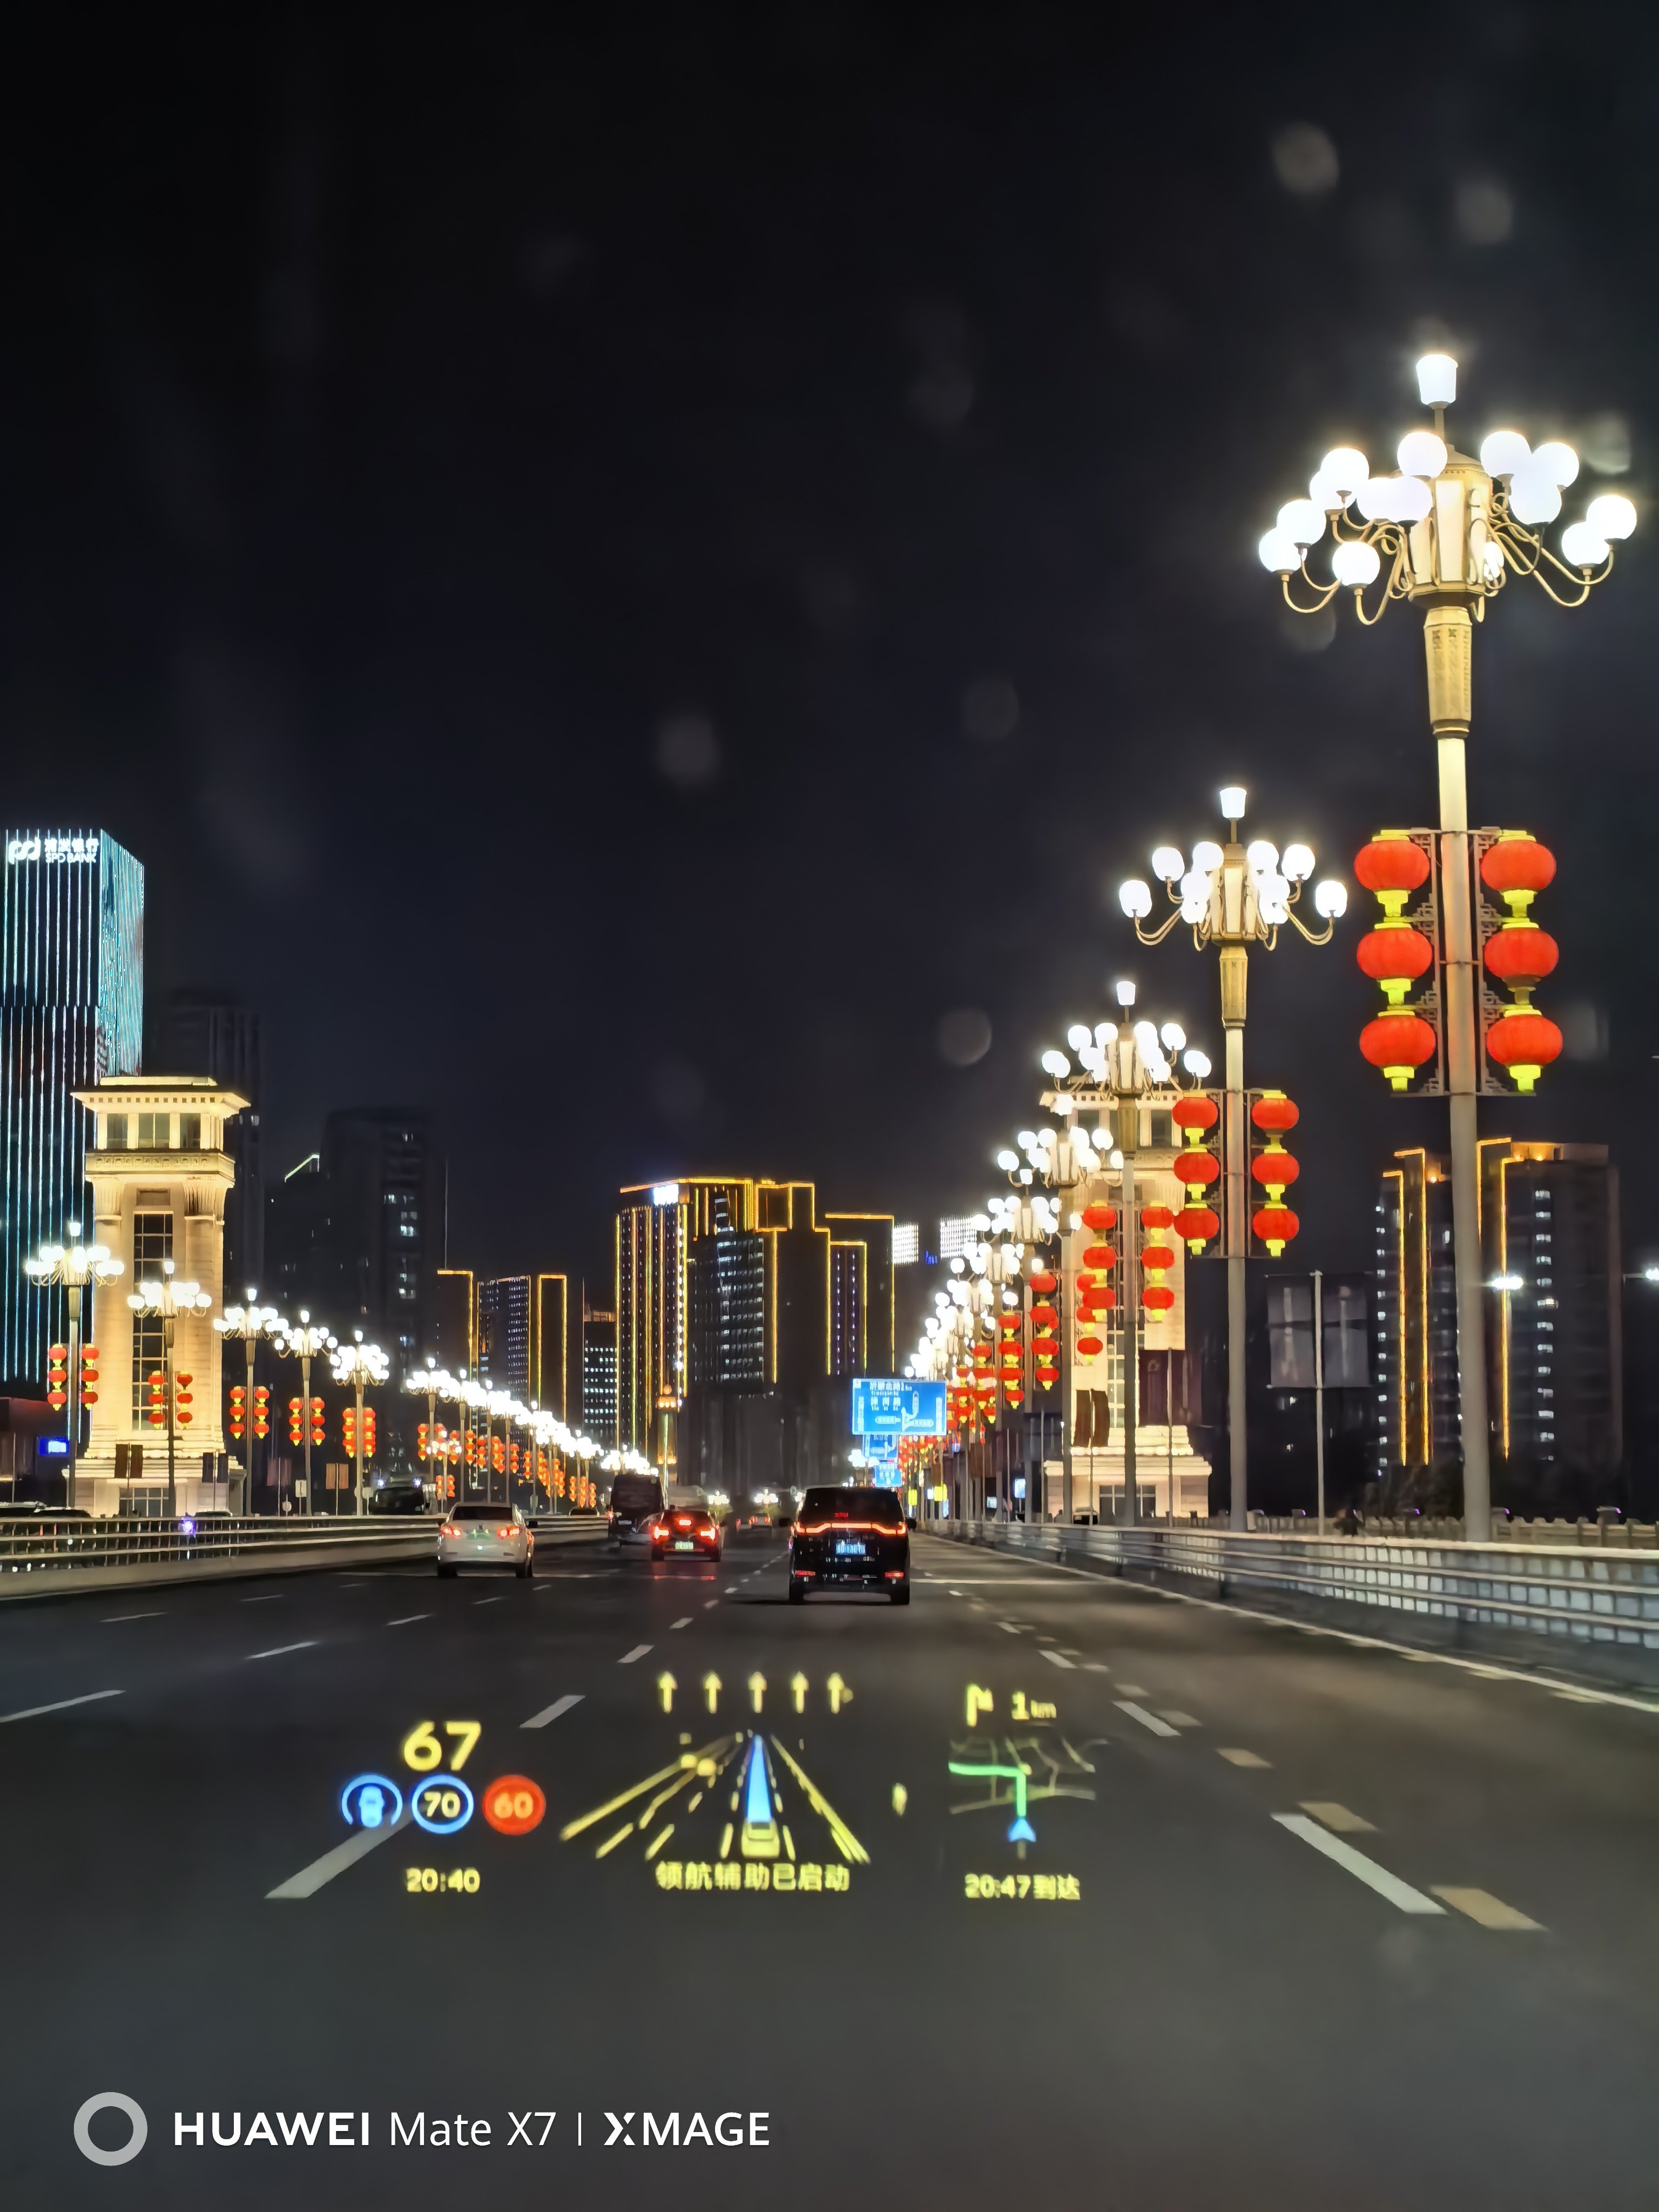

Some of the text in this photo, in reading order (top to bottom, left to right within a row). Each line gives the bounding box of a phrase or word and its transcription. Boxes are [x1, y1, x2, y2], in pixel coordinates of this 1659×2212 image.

[403, 1721, 481, 1771] 67
[423, 1791, 461, 1818] 70
[494, 1792, 534, 1819] 60
[406, 1867, 480, 1893] 20:40
[655, 1860, 850, 1892] 领航辅助已启动
